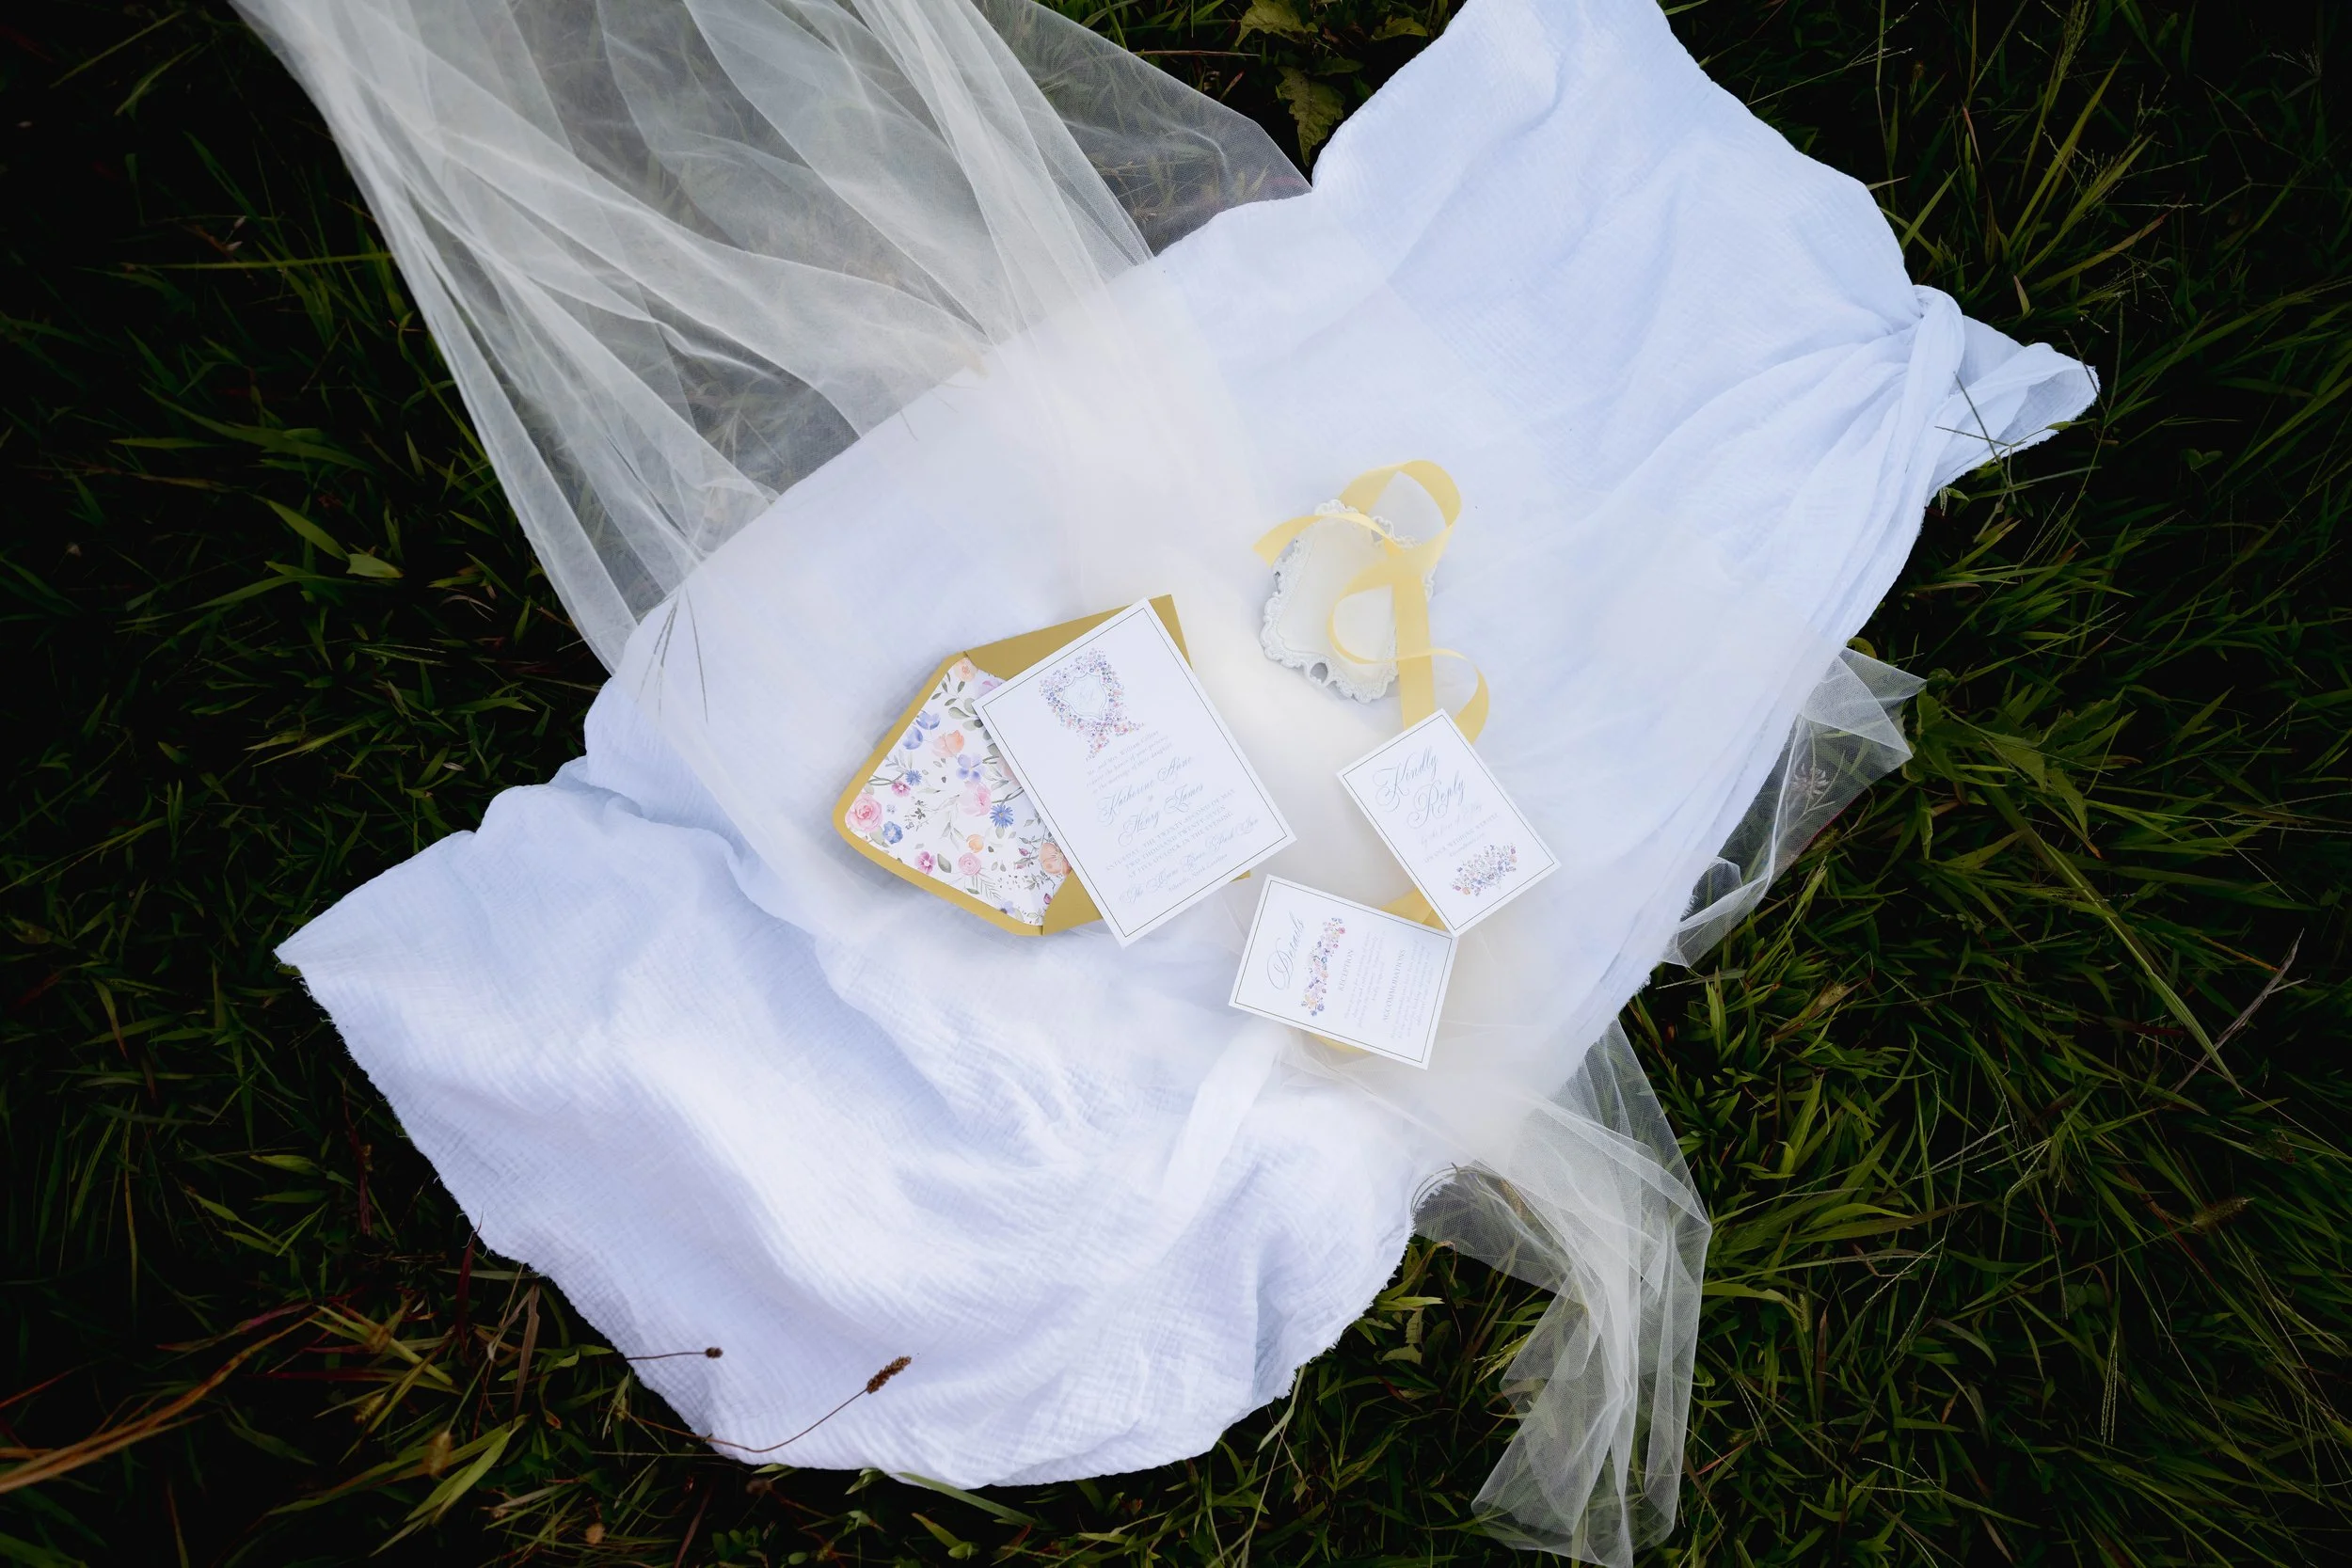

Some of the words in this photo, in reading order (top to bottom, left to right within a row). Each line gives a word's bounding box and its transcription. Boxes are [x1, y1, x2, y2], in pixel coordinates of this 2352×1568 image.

[1098, 781, 1153, 825] Katherine
[1157, 756, 1191, 783] Anne
[1374, 747, 1439, 811] Kindly
[1406, 771, 1465, 830] Reply
[1118, 811, 1158, 845] Henry
[1164, 784, 1202, 813] James
[1266, 911, 1303, 990] Details
[1337, 947, 1355, 991] RECEPTION
[1381, 947, 1406, 1022] ACCOMMODATIONS
